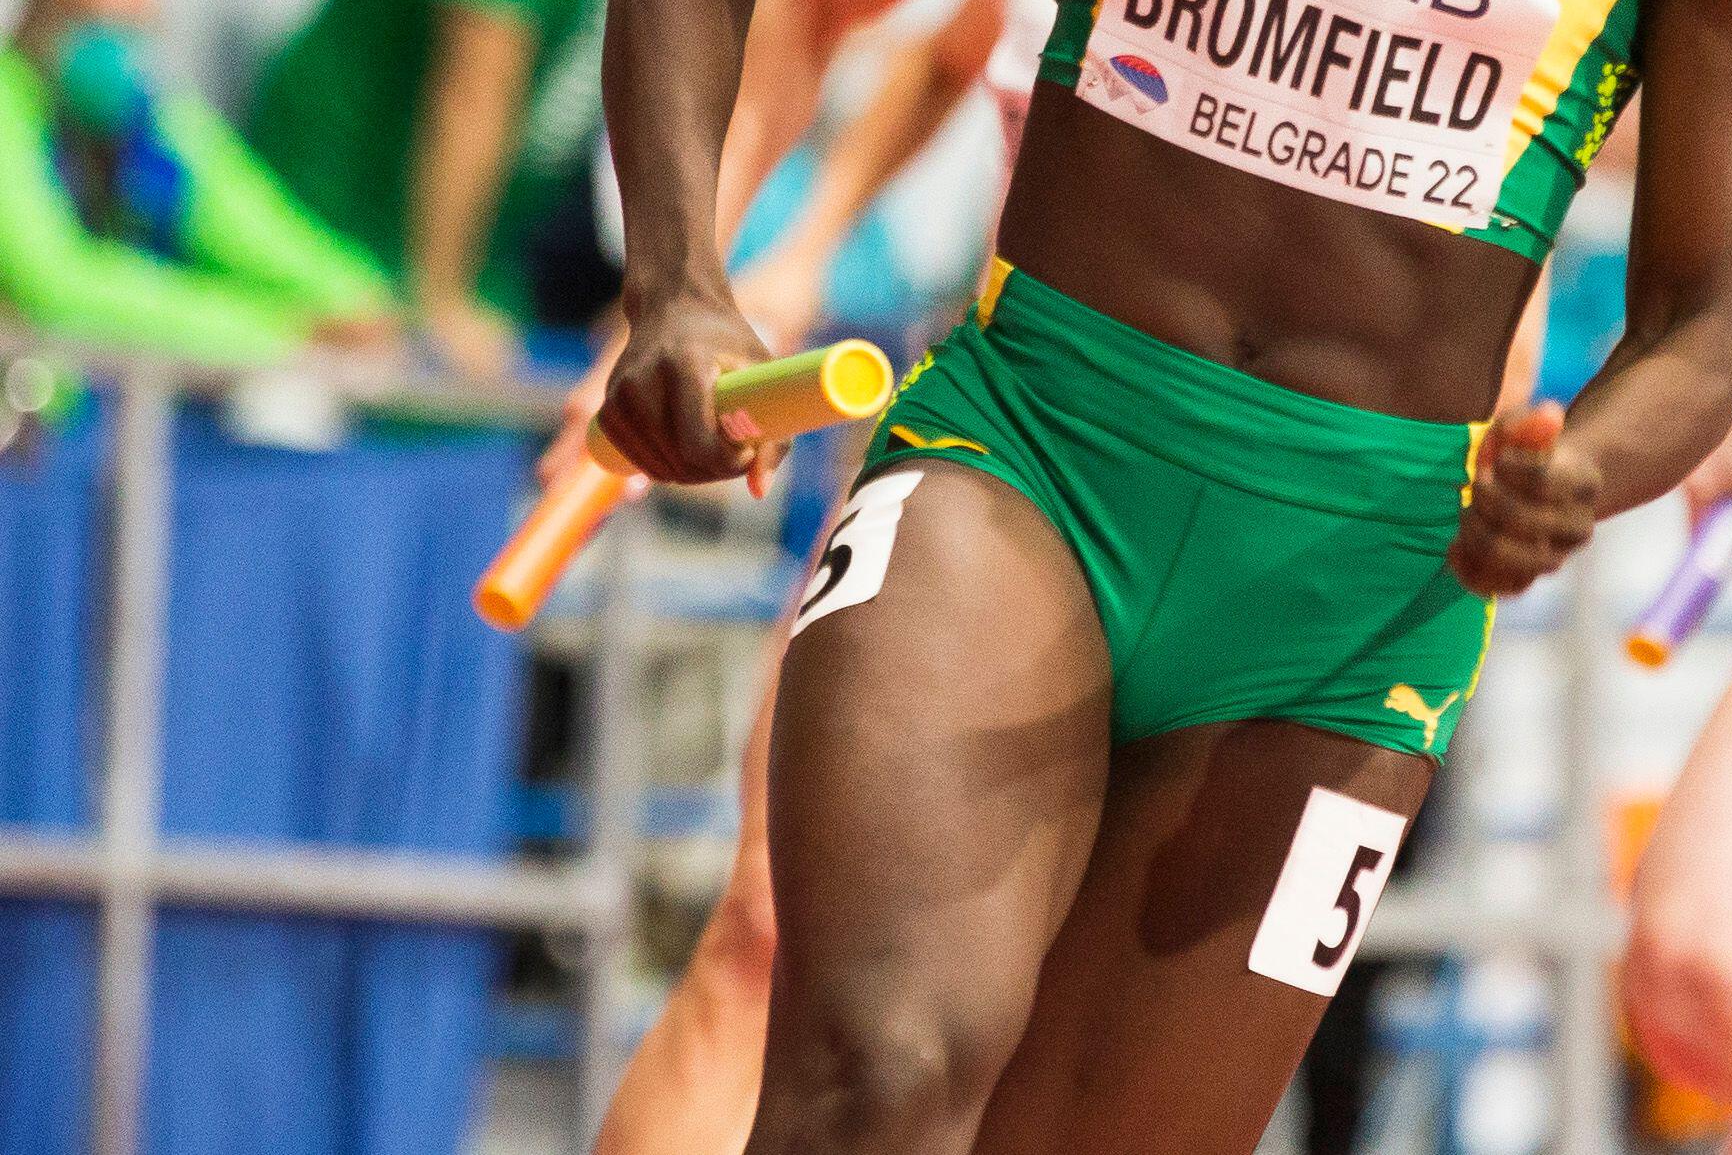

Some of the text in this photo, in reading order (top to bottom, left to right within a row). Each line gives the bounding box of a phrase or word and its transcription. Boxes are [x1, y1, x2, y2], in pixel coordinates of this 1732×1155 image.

[1190, 93, 1479, 210] BELGRADE 22
[1311, 845, 1384, 969] 5
